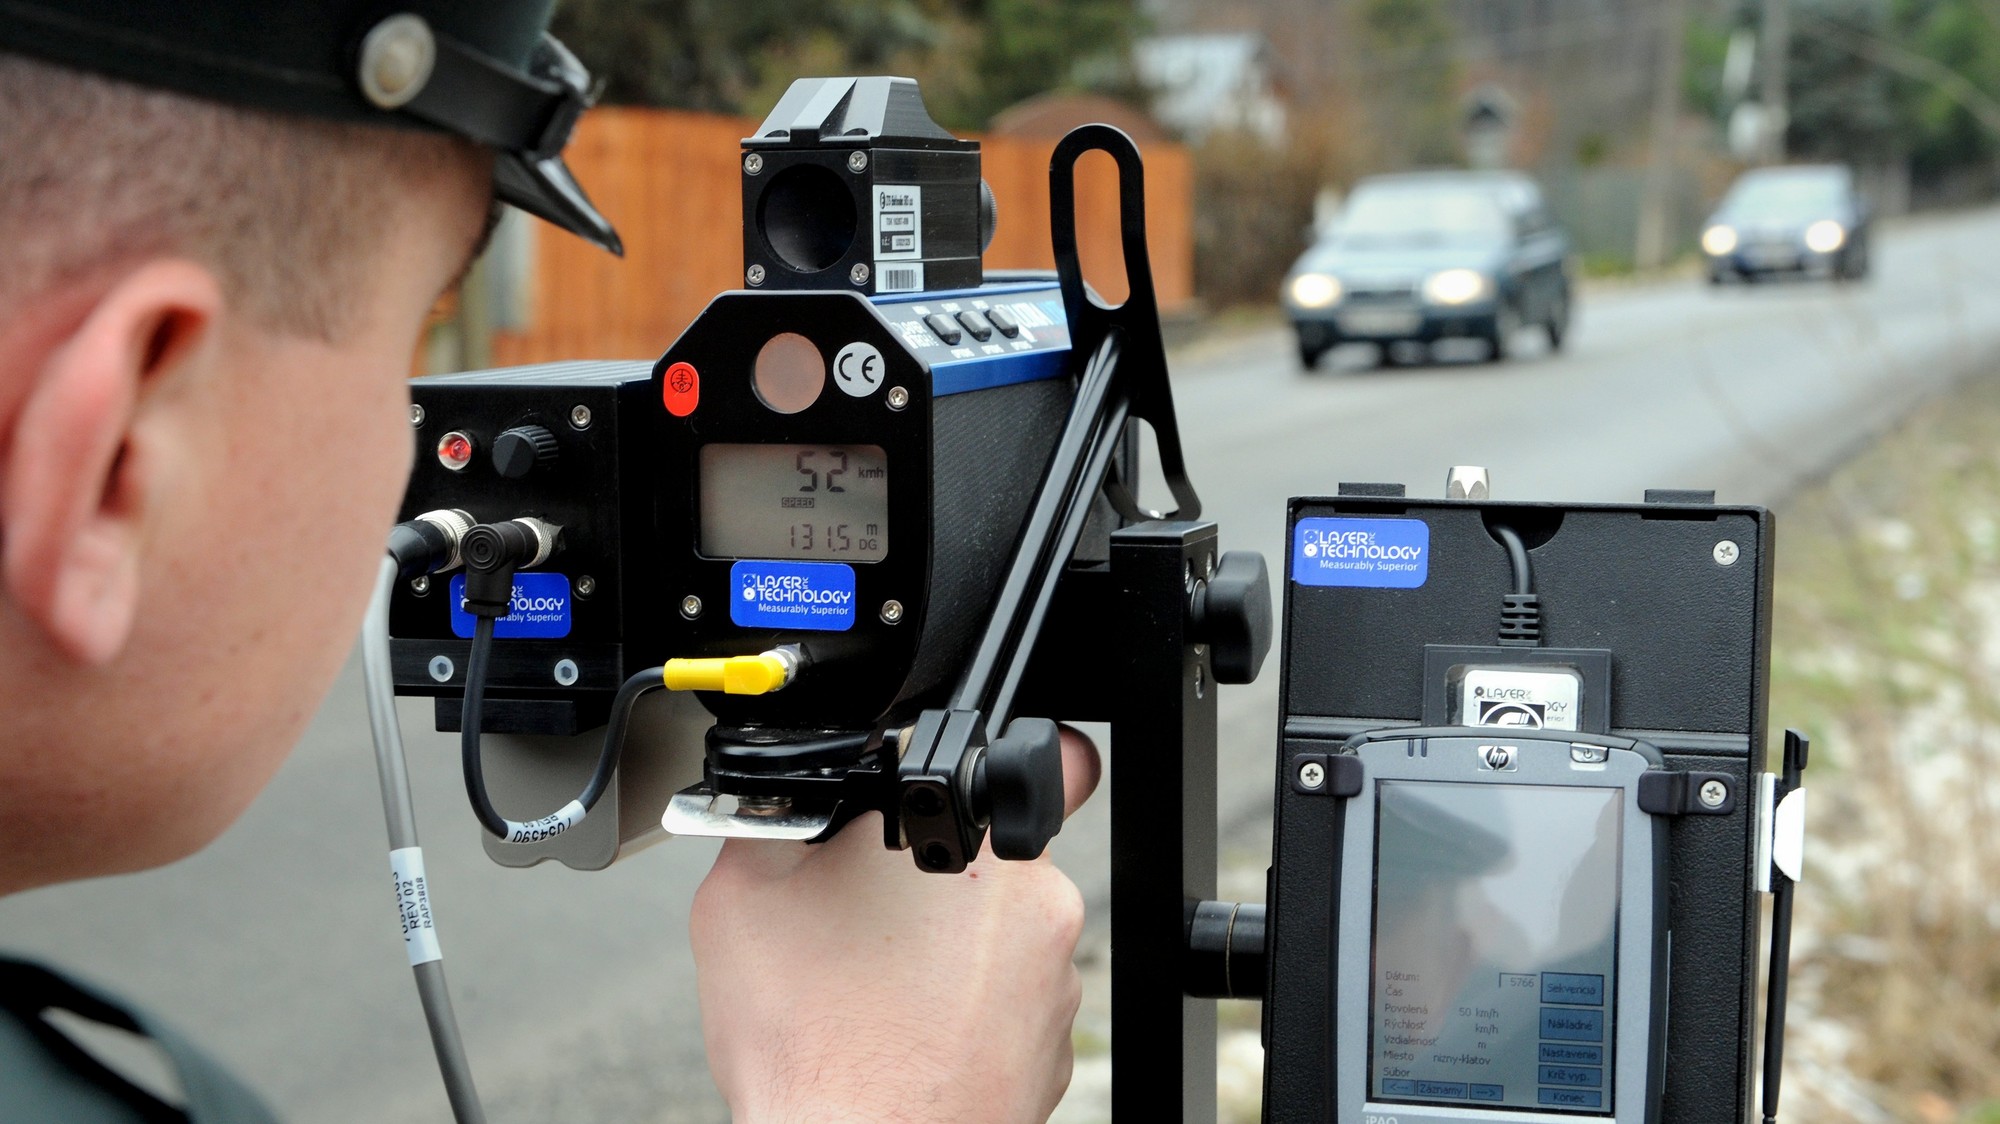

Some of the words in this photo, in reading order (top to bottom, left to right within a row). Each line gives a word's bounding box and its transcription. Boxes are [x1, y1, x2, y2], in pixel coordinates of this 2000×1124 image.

[796, 451, 848, 493] 52
[858, 467, 884, 479] kmh
[782, 497, 815, 508] SPEED
[866, 524, 878, 535] m
[1319, 531, 1369, 545] LASER
[859, 539, 878, 550] DG
[1319, 544, 1421, 560] TECHNOLOGY
[1320, 560, 1375, 571] Measurably
[1377, 561, 1418, 572] Superior
[757, 575, 802, 589] LASER
[758, 588, 851, 604] TECHNOLOGY
[758, 603, 809, 614] Measurably
[811, 604, 849, 615] Superior
[526, 612, 563, 622] Superior
[1487, 688, 1525, 699] LASER
[403, 880, 415, 897] 02
[407, 900, 421, 930] REV
[1510, 977, 1535, 988] 5766
[1459, 1008, 1471, 1017] 50
[1475, 1008, 1499, 1019] km/h
[1475, 1024, 1499, 1035] km/h
[1383, 1050, 1414, 1061] Miesto
